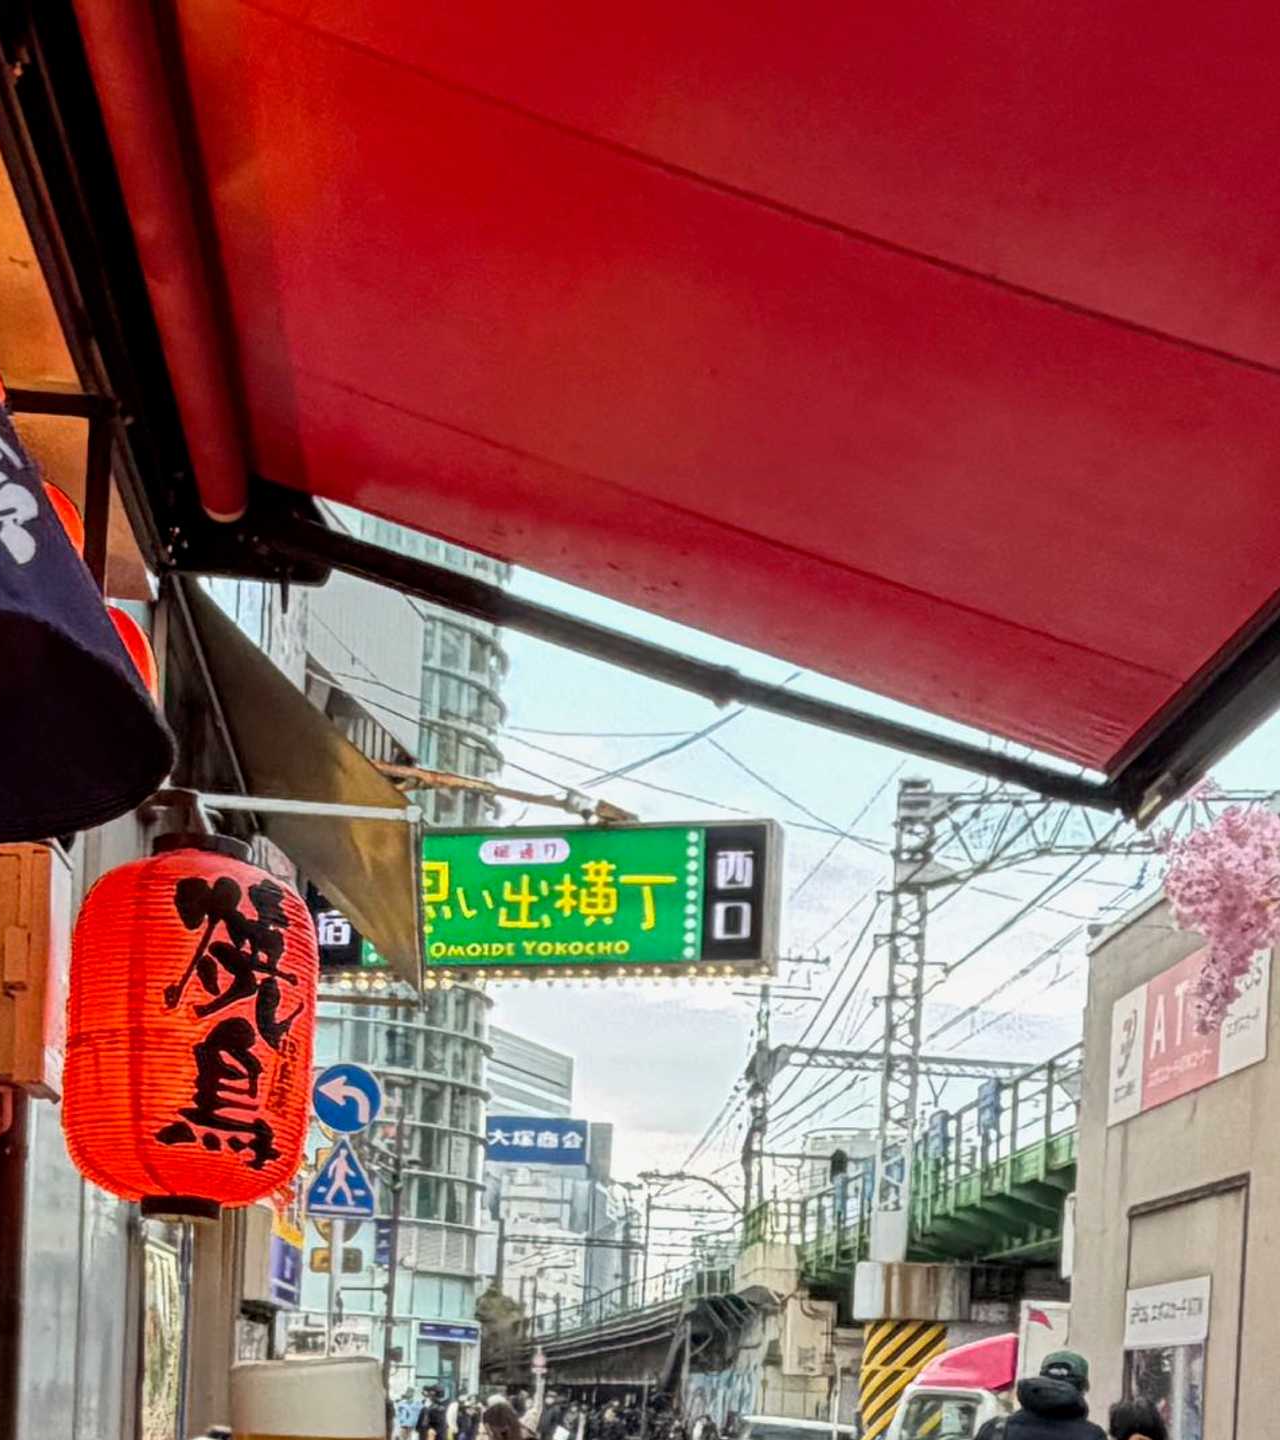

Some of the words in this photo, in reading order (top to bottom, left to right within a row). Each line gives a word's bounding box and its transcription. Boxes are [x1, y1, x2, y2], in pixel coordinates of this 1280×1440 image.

[712, 849, 755, 941] 西口
[429, 941, 516, 958] OMOIDE
[522, 939, 630, 956] YOKOCHO
[154, 876, 304, 1170] 焼鳥
[487, 1128, 584, 1149] 大塚商会
